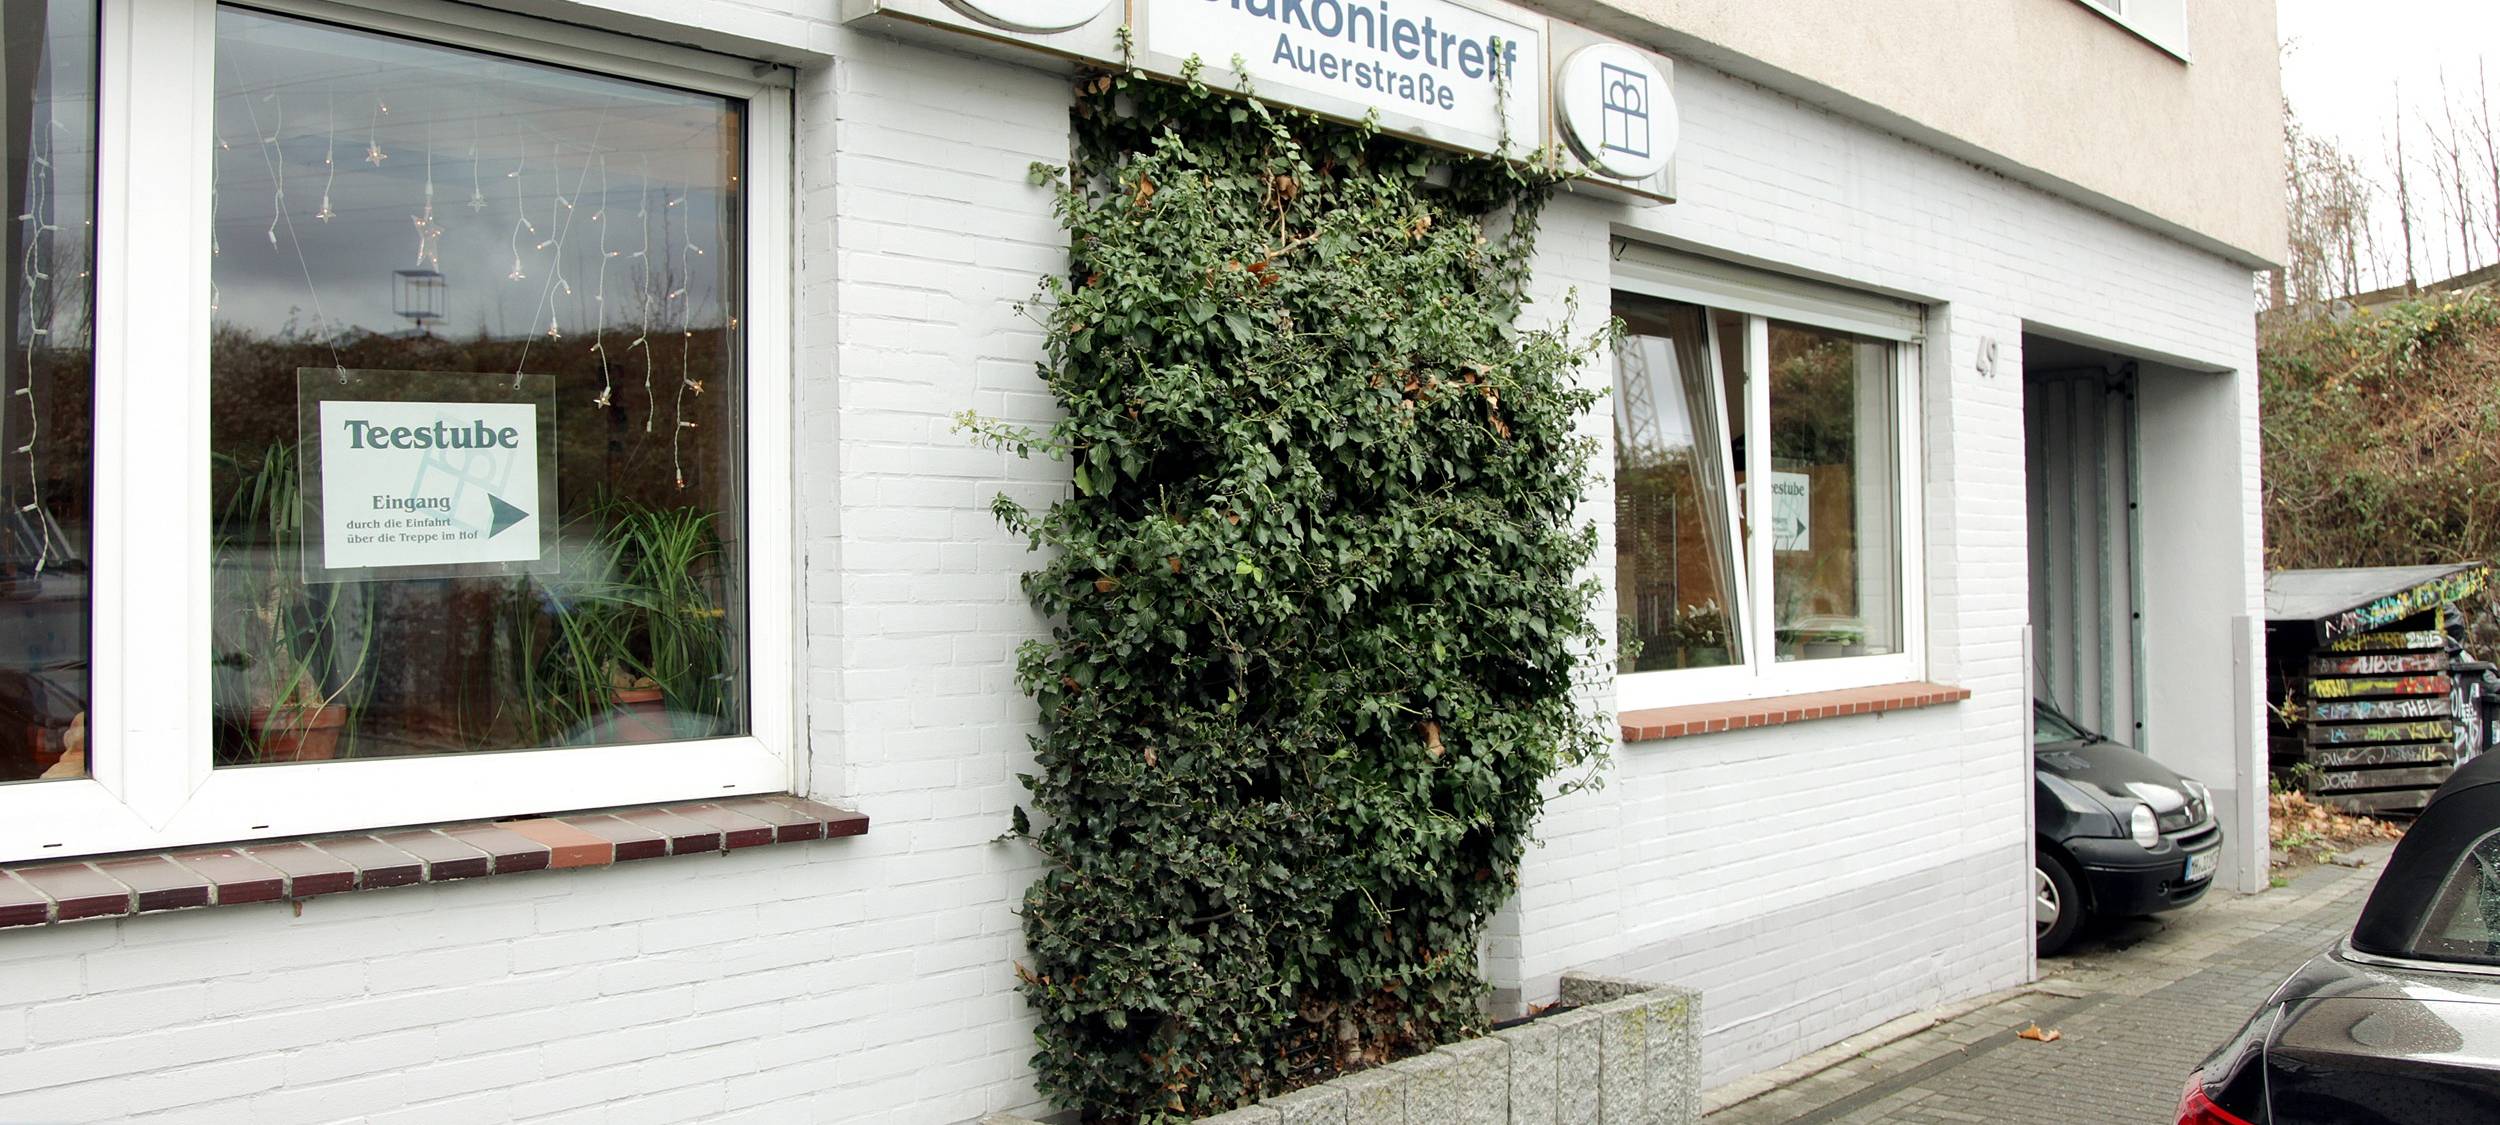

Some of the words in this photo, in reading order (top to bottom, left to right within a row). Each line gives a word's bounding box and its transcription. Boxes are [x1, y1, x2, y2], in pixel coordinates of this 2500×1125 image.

[1205, 0, 1516, 82] akonietreff
[1272, 33, 1454, 111] Auerstraße
[1975, 335, 1998, 379] 49
[344, 420, 519, 449] Teestube
[1771, 481, 1805, 497] estube
[372, 495, 451, 513] Eingang
[346, 519, 381, 530] durch
[384, 518, 402, 529] die
[405, 517, 451, 528] Einfahrt
[347, 533, 375, 544] über
[378, 533, 396, 543] die
[400, 532, 439, 544] Treppe
[442, 531, 456, 541] im
[459, 530, 479, 541] Hof
